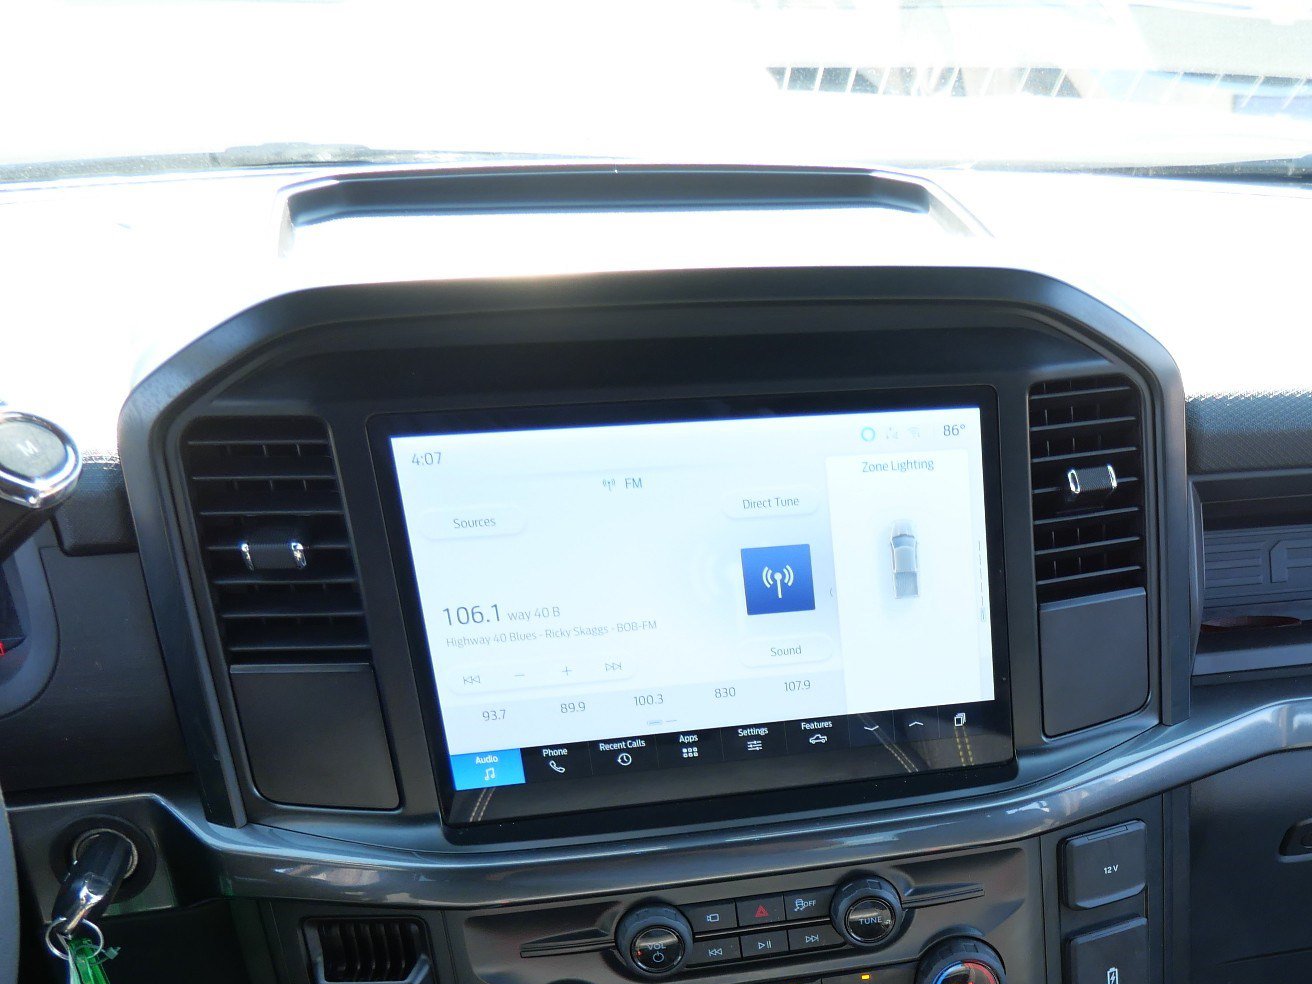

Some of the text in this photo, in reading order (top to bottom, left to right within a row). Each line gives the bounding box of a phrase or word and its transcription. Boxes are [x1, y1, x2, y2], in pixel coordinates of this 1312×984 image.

[411, 451, 443, 466] 4:07
[861, 459, 935, 473] Zone Lighting
[624, 477, 643, 490] FM
[742, 496, 800, 510] Direct Tune
[452, 515, 497, 530] Sources
[442, 603, 561, 626] 106.1 way 40 B
[446, 635, 491, 649] Highway
[493, 632, 507, 643] 40
[509, 630, 537, 642] Blues
[545, 627, 572, 639] Ricky
[573, 624, 609, 638] Skaggs
[616, 619, 657, 633] BOB-FM
[770, 644, 803, 658] Sound
[482, 679, 811, 722] 93.7 89.9 100.3 830 107.9
[738, 725, 769, 738] Settings
[801, 719, 833, 731] Features
[599, 738, 646, 752] Recent Calls
[679, 733, 699, 745] Apps
[542, 746, 568, 758] Phone
[475, 754, 499, 765] Audio
[803, 899, 817, 908] OFF
[858, 916, 883, 925] TUNE
[647, 941, 667, 950] VOL
